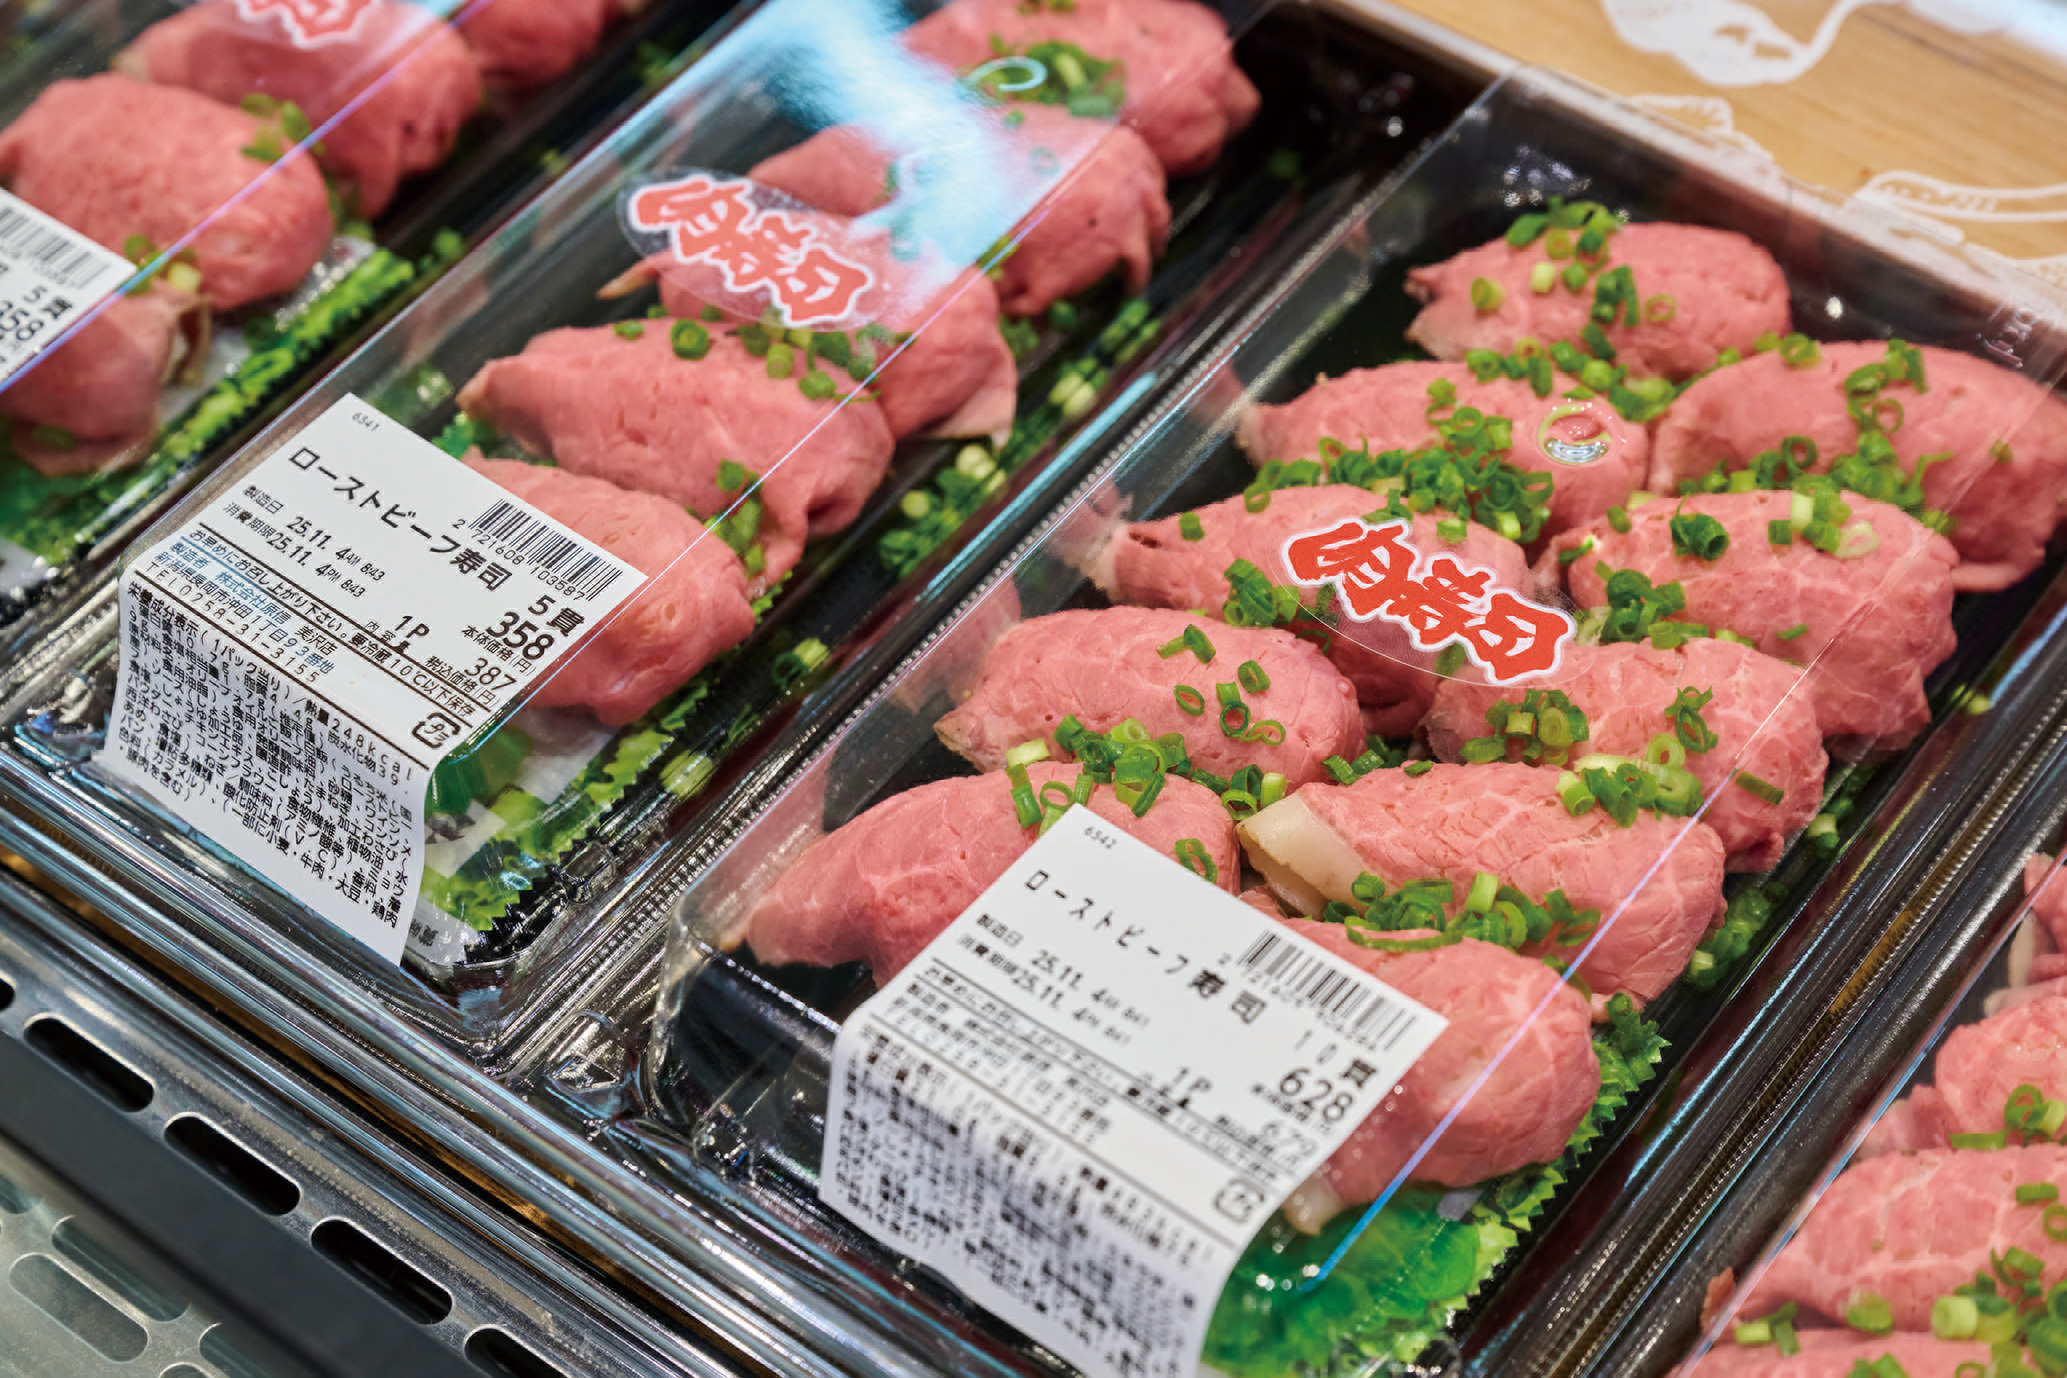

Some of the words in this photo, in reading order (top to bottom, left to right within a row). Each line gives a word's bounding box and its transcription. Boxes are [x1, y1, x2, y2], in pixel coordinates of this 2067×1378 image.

[243, 485, 284, 514] 製造日
[286, 516, 332, 550] 25.11.
[360, 563, 385, 581] 8:43
[289, 447, 512, 591] ローストビーフ寿司
[528, 595, 585, 637] 5貫
[452, 518, 466, 530] 2
[471, 529, 525, 565] 721608
[530, 566, 585, 601] 103587
[170, 541, 210, 570] 製造者
[214, 571, 292, 625] 株式会社原信
[340, 579, 366, 597] 8:43
[1284, 519, 1573, 684] 肉寿司
[461, 625, 537, 676] 本体価格(円)
[486, 611, 555, 660] 358
[464, 658, 518, 690] 387
[1280, 1068, 1353, 1122] 628
